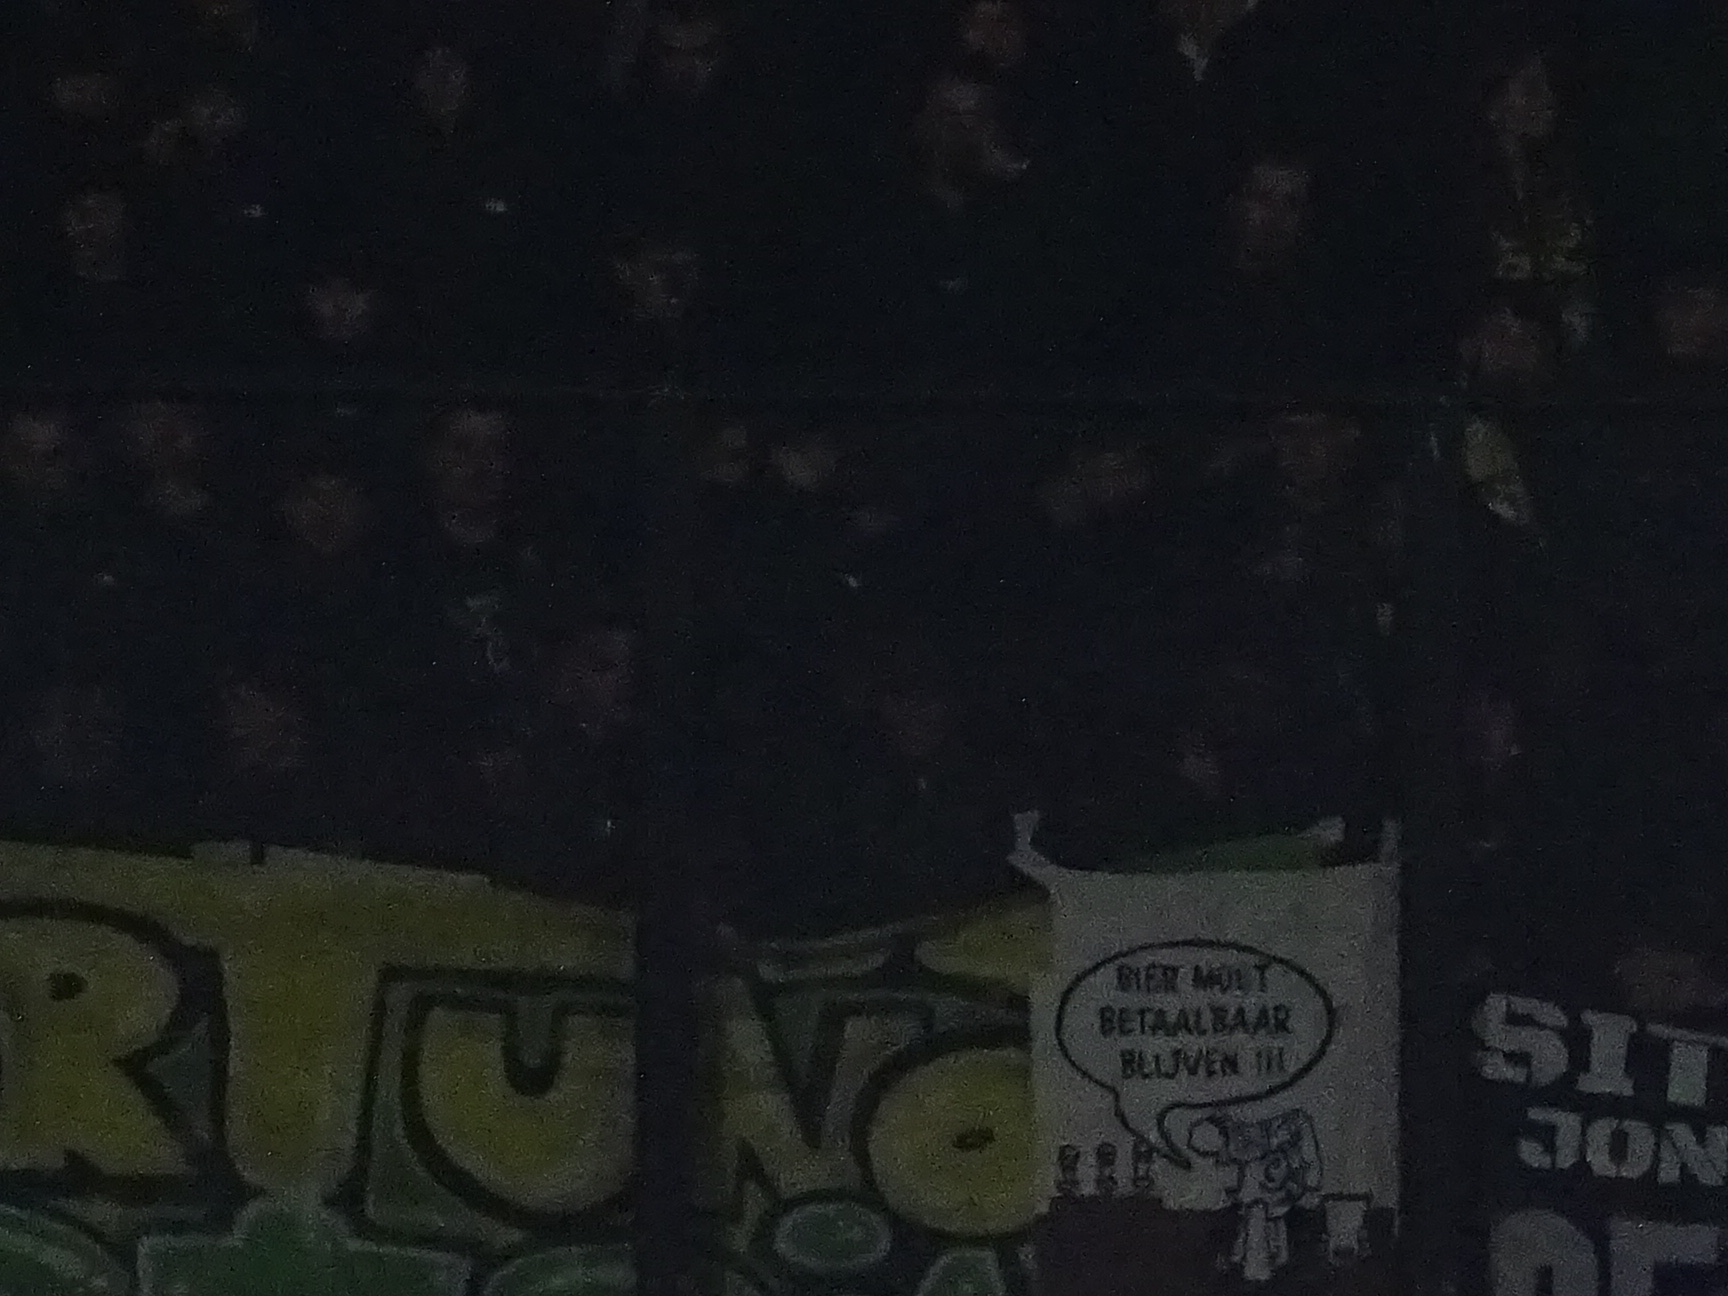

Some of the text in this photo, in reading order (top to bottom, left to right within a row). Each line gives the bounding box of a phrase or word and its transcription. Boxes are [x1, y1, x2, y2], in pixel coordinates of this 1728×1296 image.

[1116, 964, 1180, 993] BIER
[1099, 1003, 1293, 1038] BETAALBAAR
[1119, 1047, 1240, 1081] BLIJVEN
